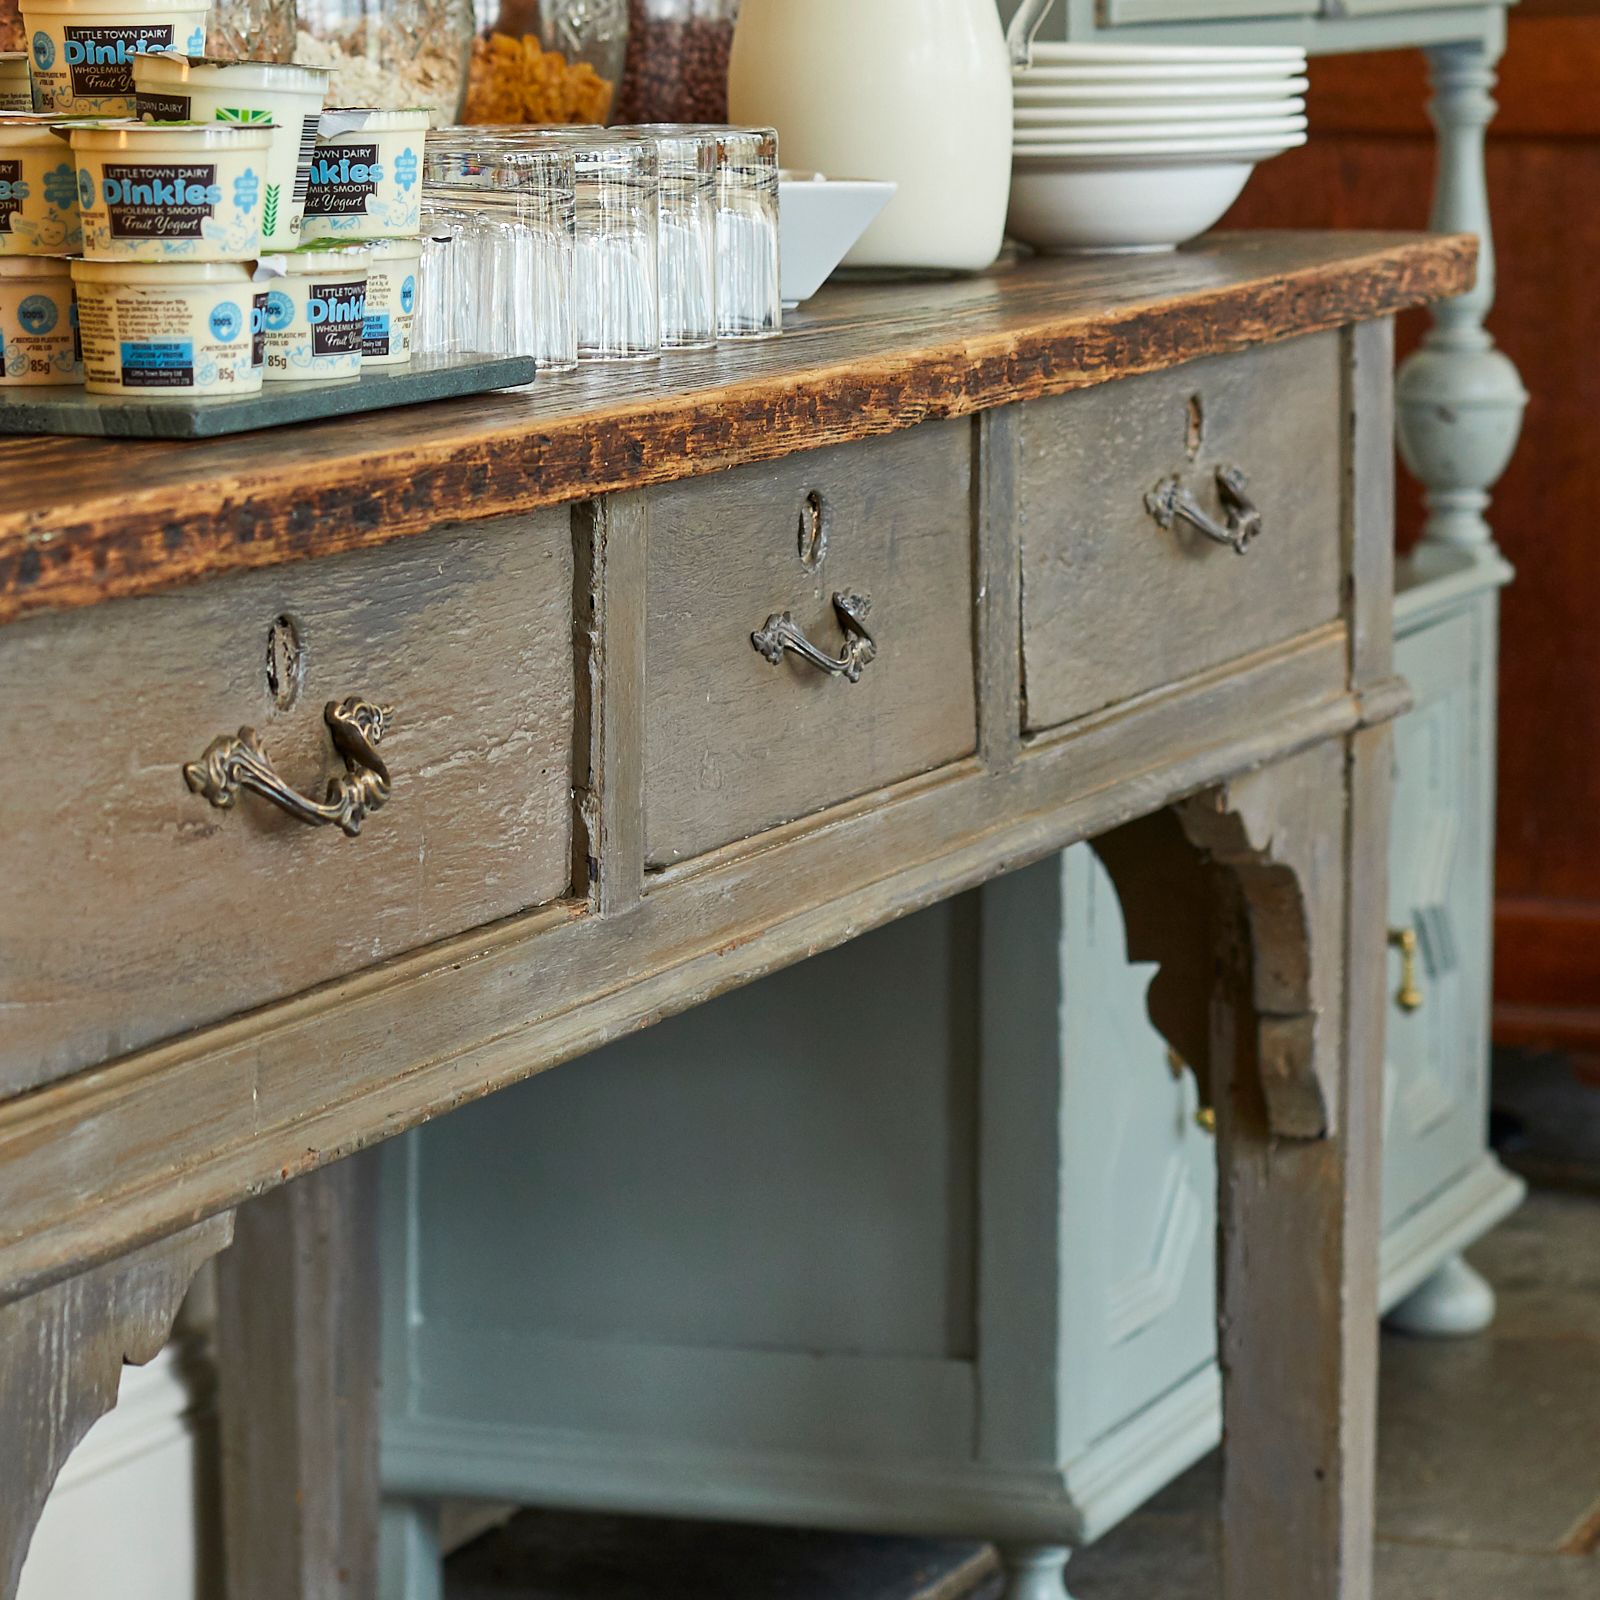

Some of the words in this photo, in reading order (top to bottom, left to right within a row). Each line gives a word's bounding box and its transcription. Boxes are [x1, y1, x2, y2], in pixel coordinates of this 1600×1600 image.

[71, 30, 102, 40] LITTLE
[104, 30, 137, 40] TOWN
[140, 29, 168, 39] DAIRY
[74, 66, 127, 74] WHOLEMILK
[85, 74, 115, 88] Fruit
[159, 102, 183, 113] DAIRY
[313, 150, 339, 159] OWN
[343, 149, 371, 158] DAIRY
[108, 169, 138, 178] LITTLE
[140, 169, 175, 178] TOWN
[178, 169, 209, 178] DAIRY
[310, 159, 384, 184] kies
[102, 178, 222, 205] Dinkies
[333, 185, 373, 193] SMOOTH
[305, 197, 319, 208] uit
[321, 194, 362, 211] Yogurt
[112, 207, 164, 215] WHOLEMILK
[167, 207, 210, 215] SMOOTH
[121, 216, 152, 229] Fruit
[154, 216, 198, 234] Yogurt
[317, 287, 343, 298] LITTLE
[307, 295, 363, 323] Dinki
[213, 318, 232, 326] 100%
[325, 332, 347, 347] Fruit
[31, 360, 50, 374] 85g
[268, 355, 287, 369] 85g
[219, 368, 234, 382] 85g
